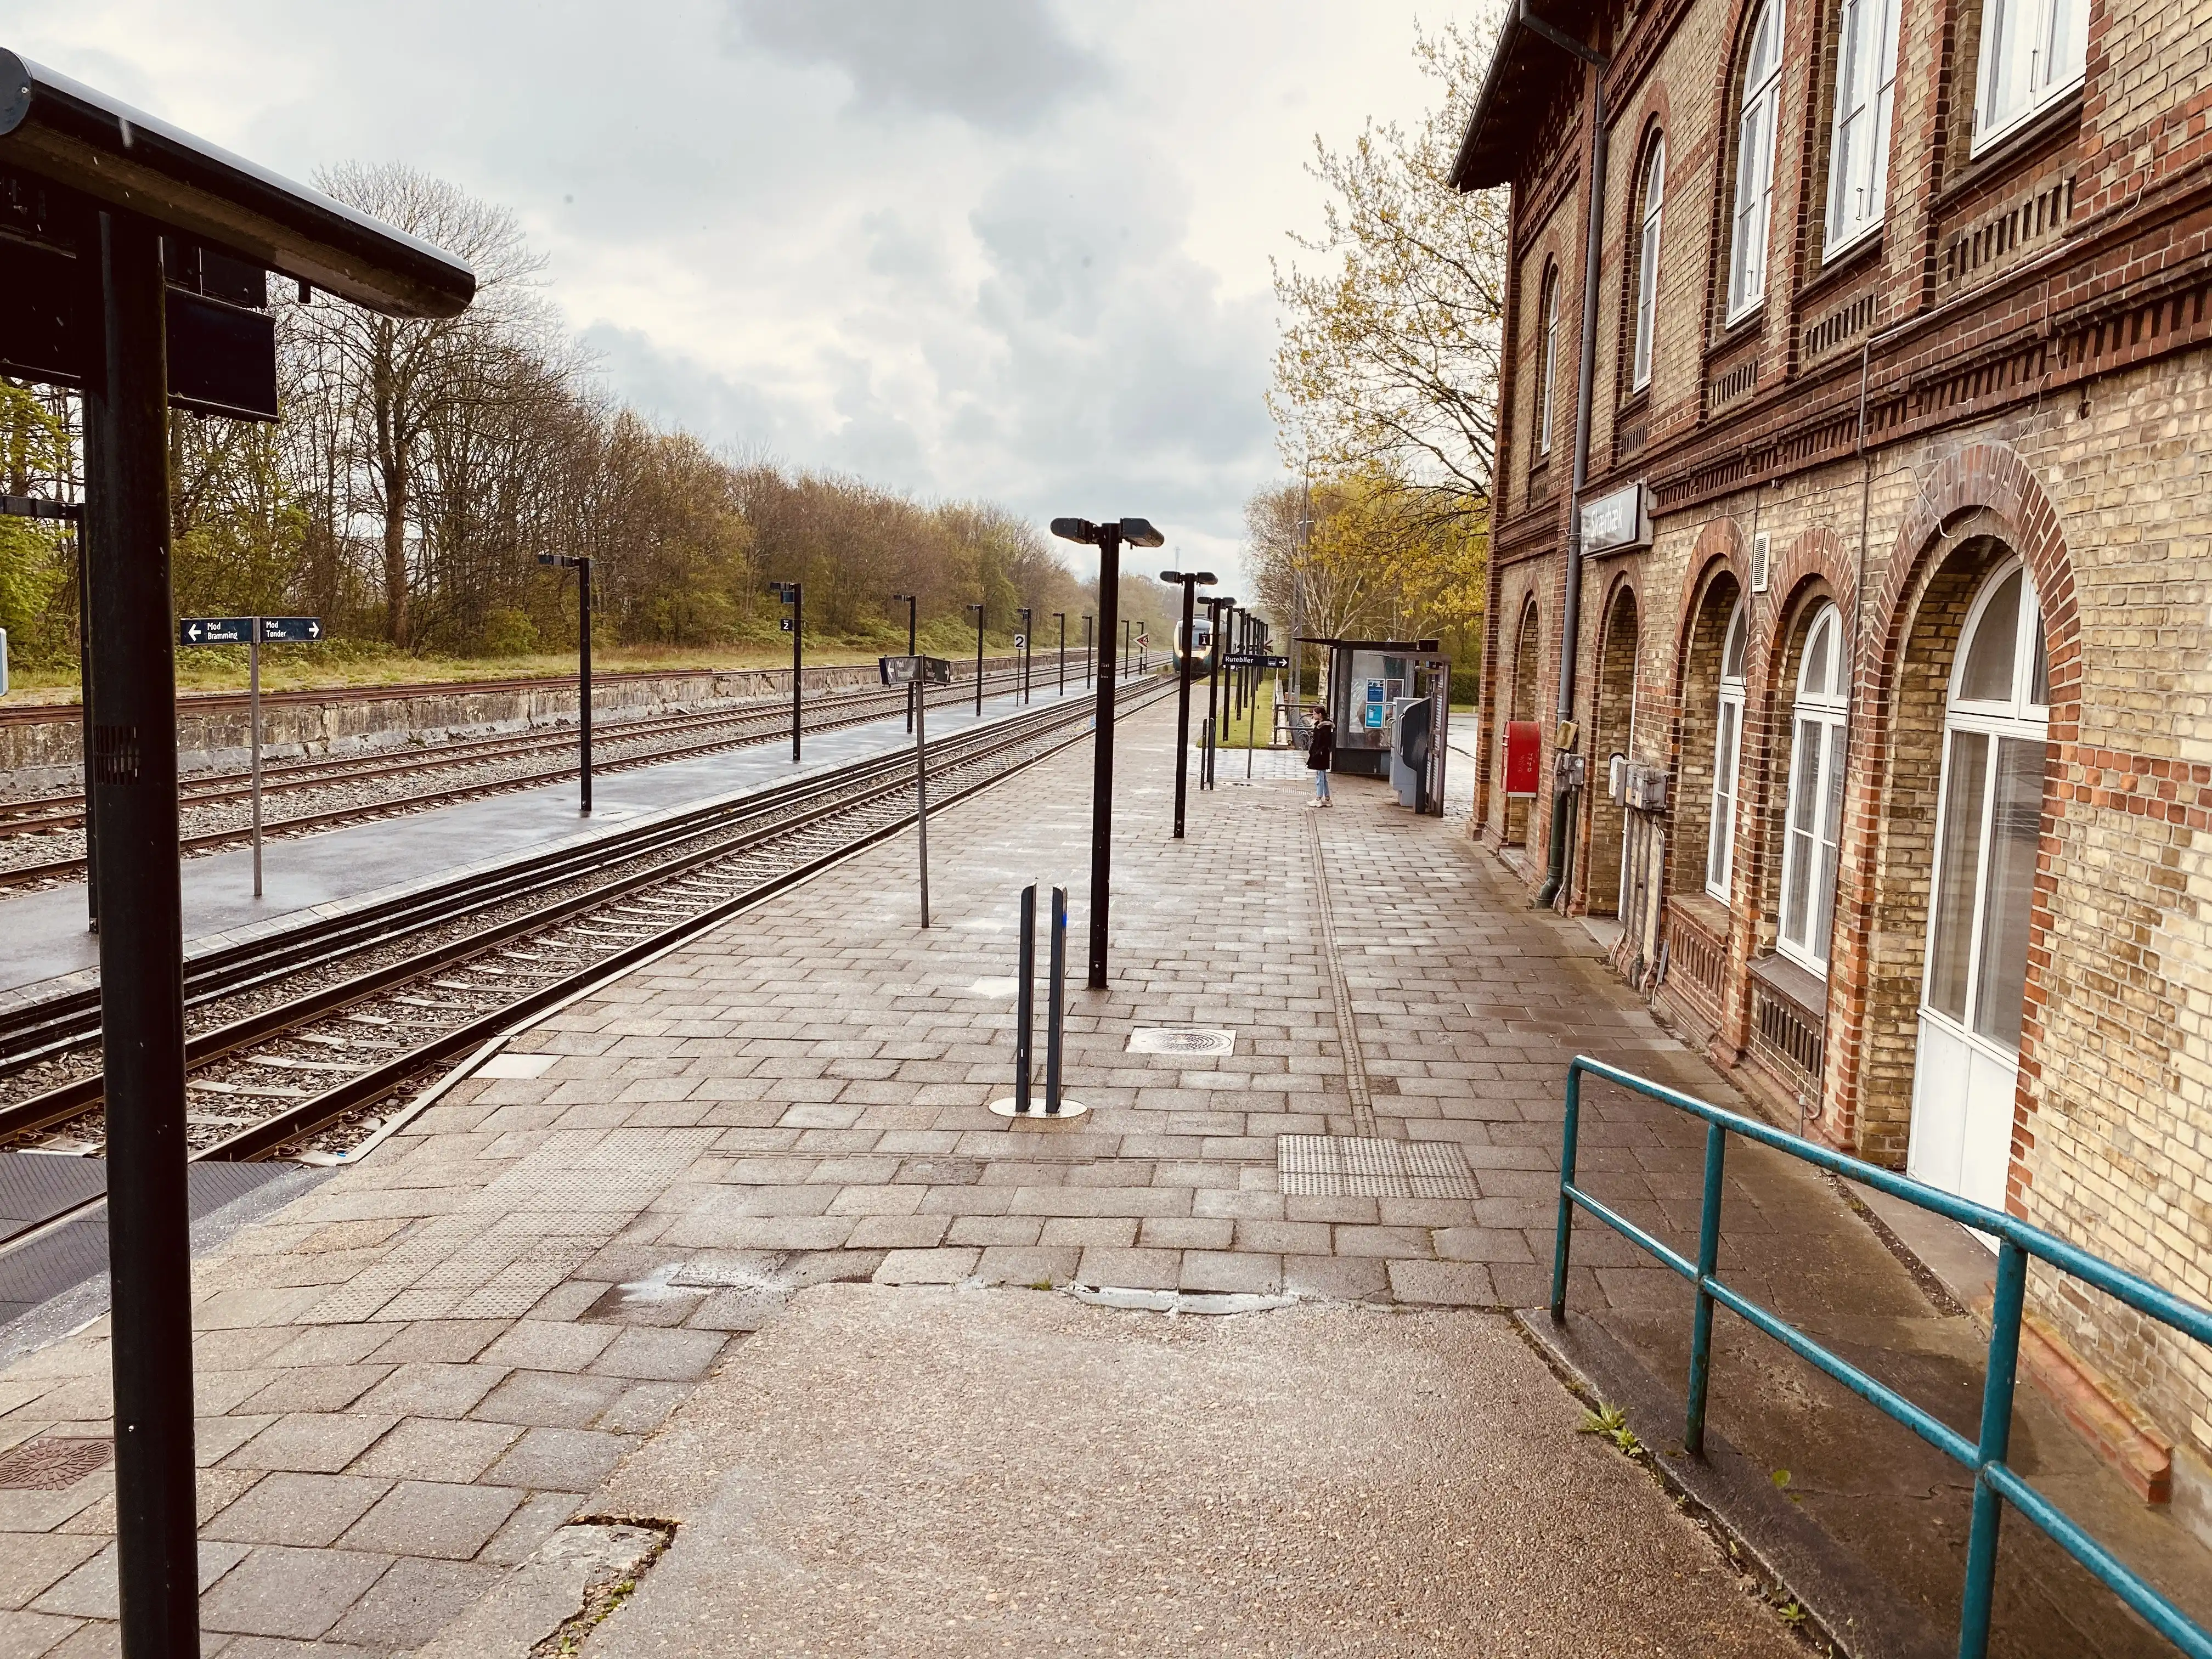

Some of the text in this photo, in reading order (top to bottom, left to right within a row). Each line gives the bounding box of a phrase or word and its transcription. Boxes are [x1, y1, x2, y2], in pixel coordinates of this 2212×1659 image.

[1591, 498, 1623, 538] Skærbæk
[207, 622, 221, 630] Mod
[207, 631, 238, 640] Bramming
[1016, 636, 1024, 647] 2
